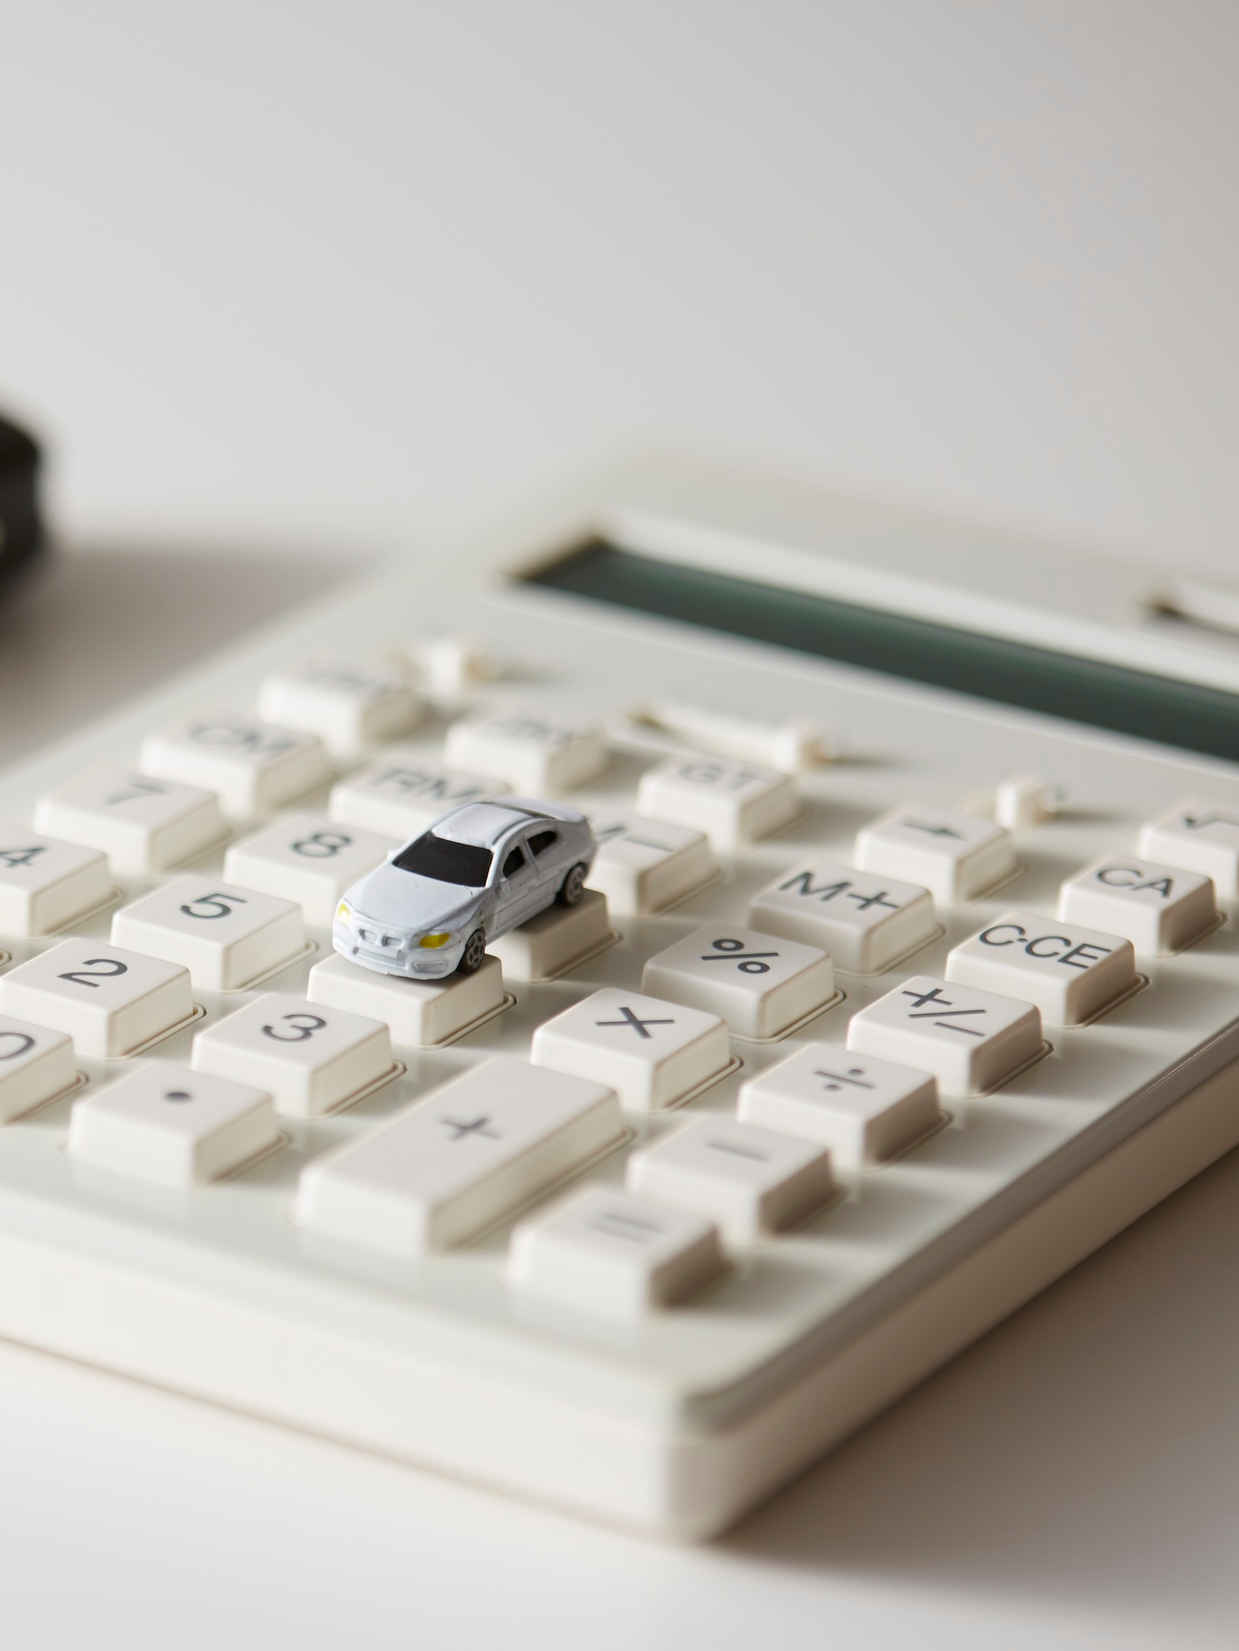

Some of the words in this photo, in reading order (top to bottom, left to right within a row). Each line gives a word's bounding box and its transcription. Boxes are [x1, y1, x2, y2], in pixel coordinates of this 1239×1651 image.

[292, 832, 352, 859] 8
[779, 870, 900, 911] M+
[1096, 867, 1175, 899] CA
[180, 892, 249, 920] 5
[701, 937, 780, 975] %
[57, 958, 128, 988] 2
[262, 1012, 328, 1043] 3
